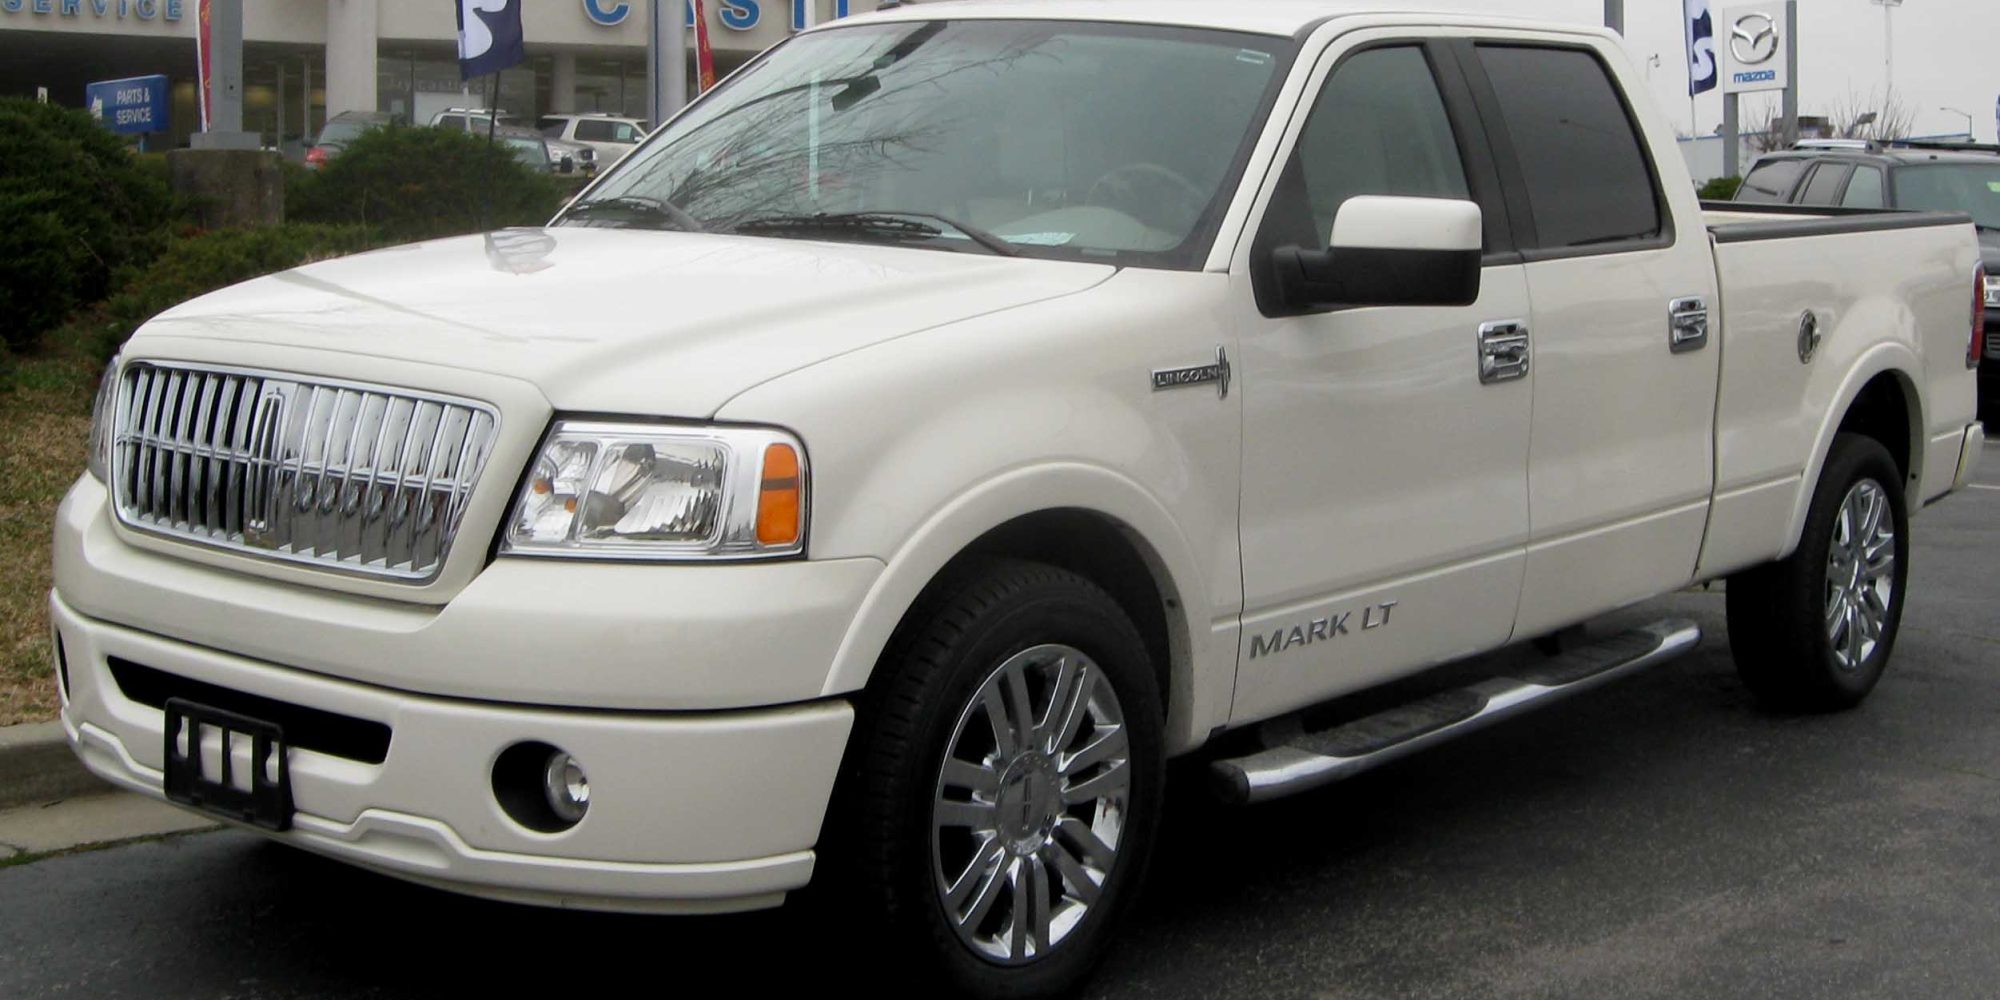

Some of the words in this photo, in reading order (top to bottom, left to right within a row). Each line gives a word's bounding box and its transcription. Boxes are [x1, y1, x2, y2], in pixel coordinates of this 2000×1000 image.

[1733, 70, 1775, 84] mazda
[116, 88, 142, 105] PARTS
[144, 87, 150, 103] &
[116, 107, 152, 125] SERVICE
[1156, 366, 1218, 386] LINCOLN
[1249, 611, 1351, 659] MARK
[1361, 600, 1398, 631] LT
